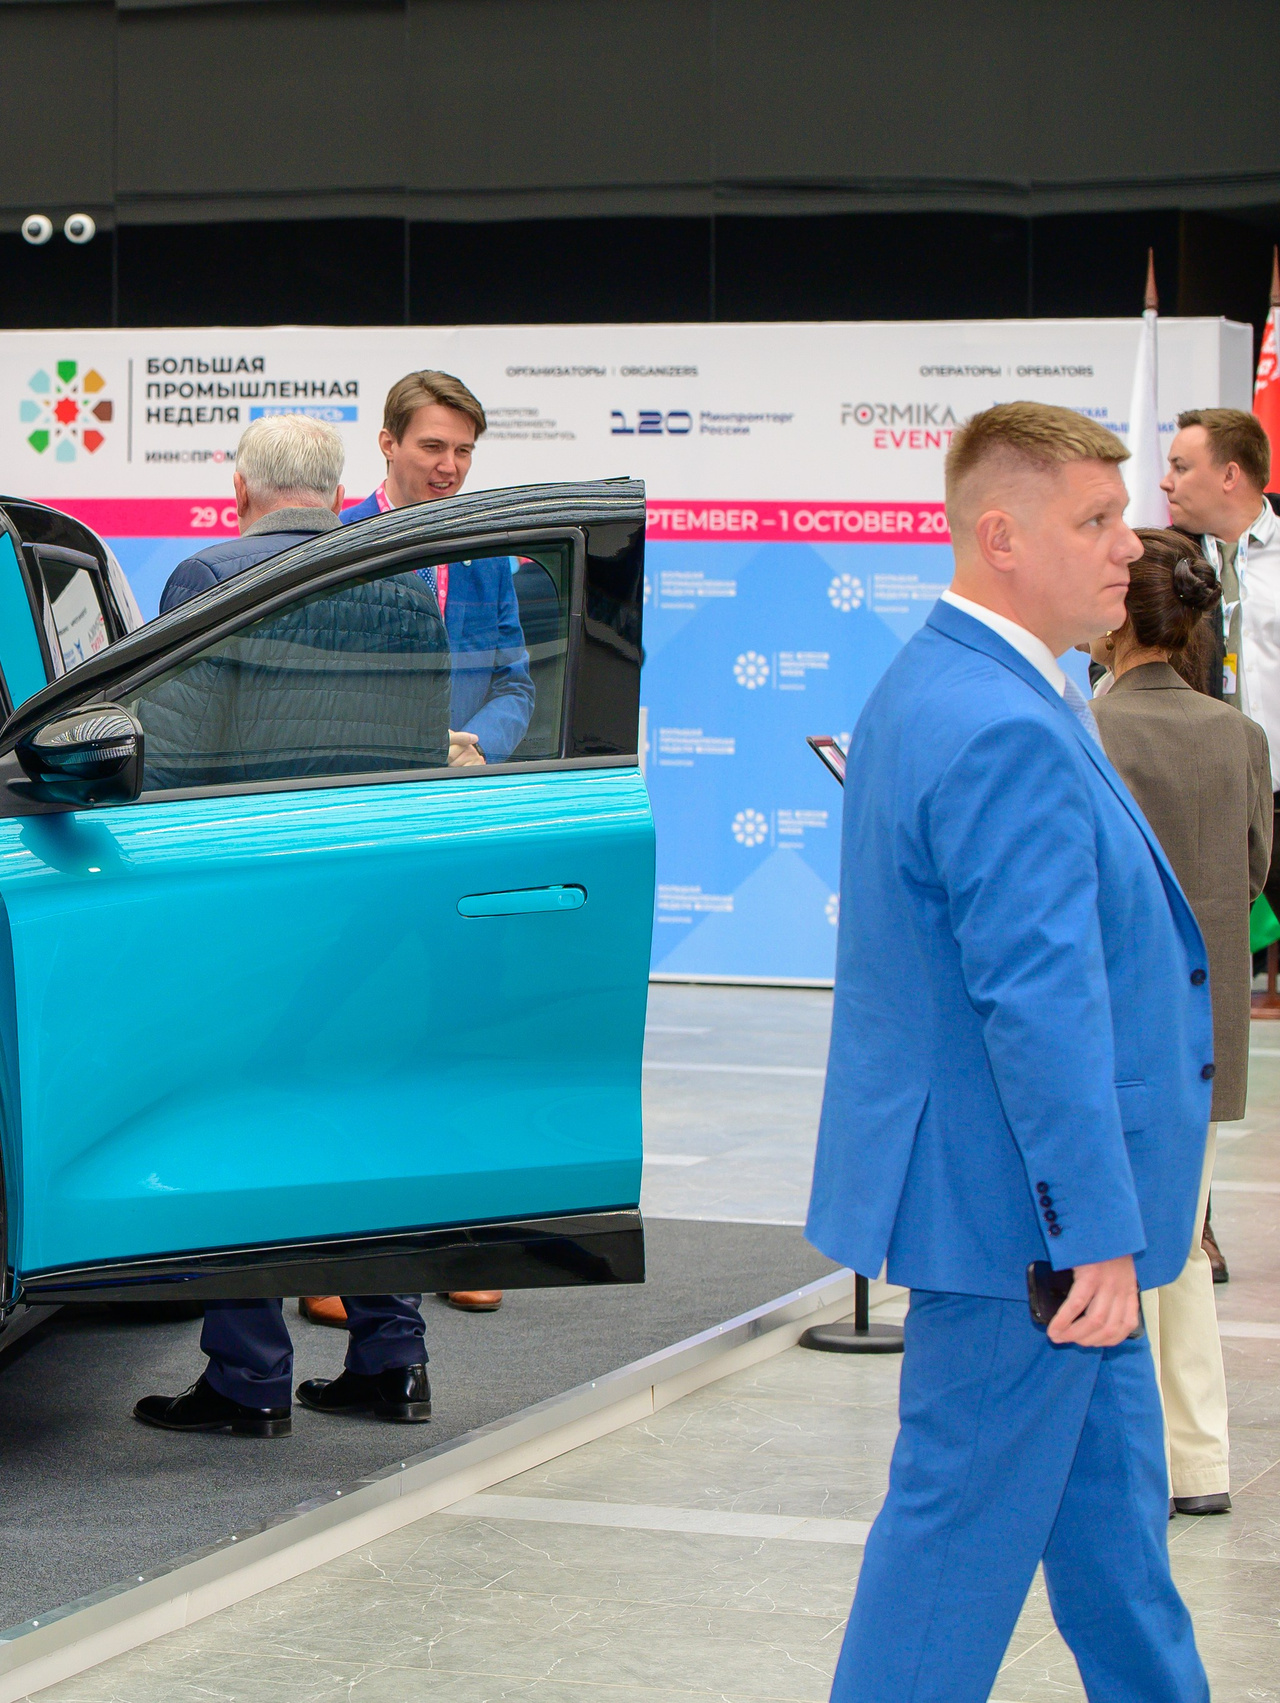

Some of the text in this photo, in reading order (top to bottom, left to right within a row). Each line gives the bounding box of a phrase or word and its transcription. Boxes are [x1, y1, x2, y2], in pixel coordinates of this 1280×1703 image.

[147, 357, 265, 375] БОЛЬШАЯ
[506, 365, 607, 377] ОРГАНИЗАТОРЫ
[620, 365, 699, 377] ORGANIZERS
[919, 364, 1002, 378] ОПЕРАТОРЫ
[1016, 364, 1095, 378] OPERATORS
[146, 381, 359, 399] ПРОМЫШЛЕННАЯ
[146, 405, 240, 426] НЕДЕЛЯ
[611, 409, 693, 435] 120
[841, 402, 958, 427] FORMIKA
[700, 424, 751, 436] России
[874, 429, 953, 450] EVENT
[190, 506, 218, 528] 29
[646, 508, 759, 532] PTEMBER
[793, 510, 913, 533] OCTOBER
[917, 511, 951, 534] 20
